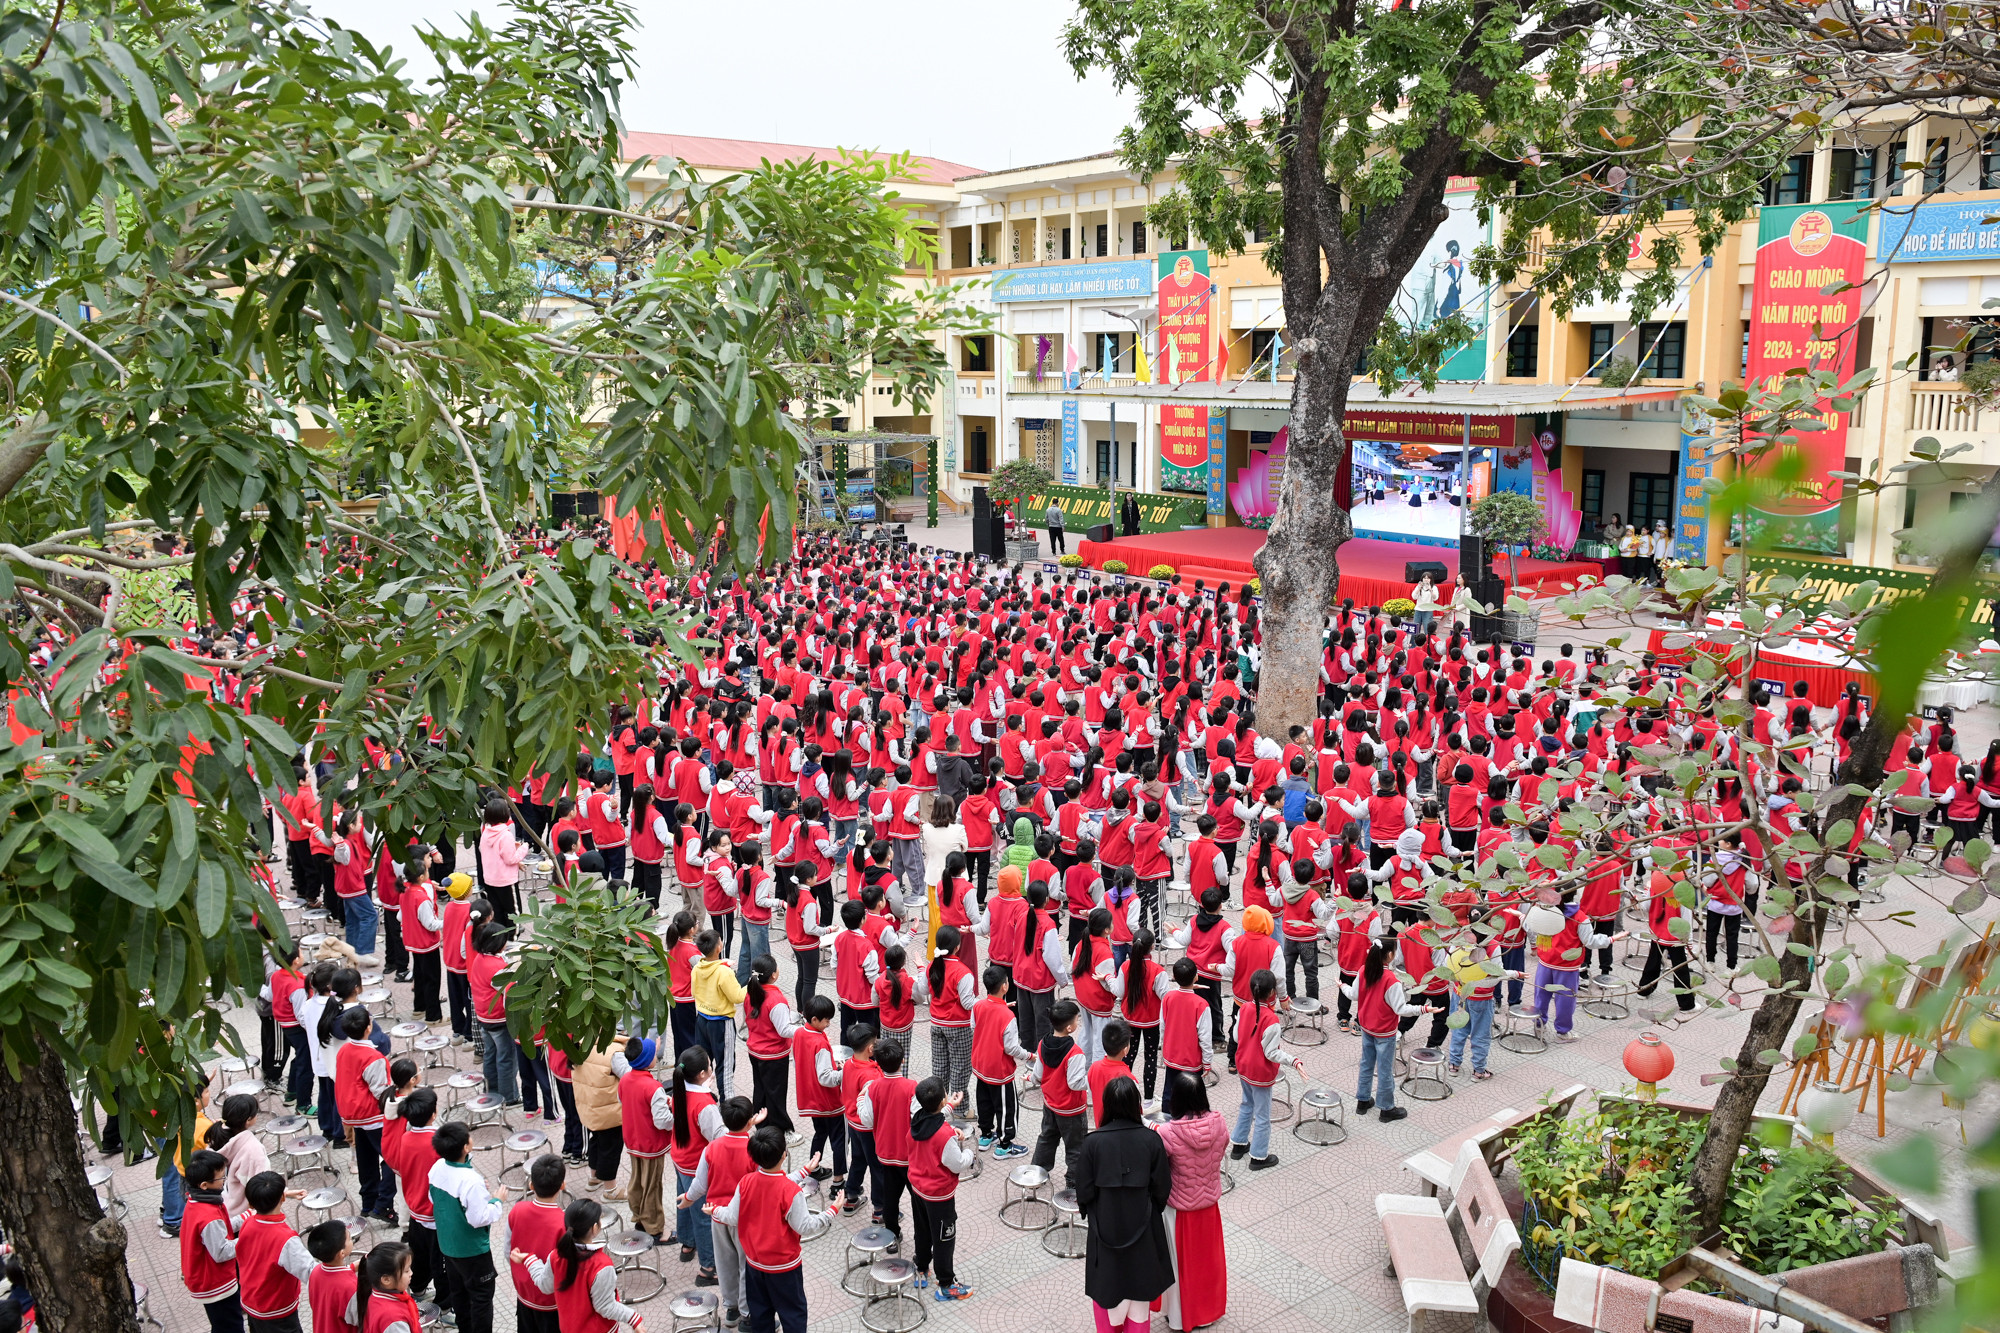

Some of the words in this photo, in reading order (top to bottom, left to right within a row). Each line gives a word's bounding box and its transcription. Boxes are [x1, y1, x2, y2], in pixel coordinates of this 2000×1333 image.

[1904, 234, 1927, 256] HỌC
[1930, 226, 1947, 251] ĐỂ
[1948, 225, 1977, 250] HIỂU
[1978, 225, 2000, 249] BIẾ
[1013, 282, 1036, 296] NHỮNG
[1038, 281, 1048, 294] LỜI
[1050, 281, 1064, 294] HAY,
[1066, 280, 1081, 293] LÀM
[1083, 276, 1106, 292] NHIỀU
[1107, 276, 1124, 294] VIỆC
[1126, 273, 1140, 290] TỐT
[1770, 266, 1802, 289] CHÀO
[1195, 313, 1207, 328] HỌC
[1761, 301, 1789, 324] NĂM
[1792, 304, 1818, 328] HỌC
[1821, 301, 1848, 324] MỚI
[1763, 340, 1793, 359] 2024
[1804, 340, 1837, 360] 2025
[1182, 422, 1196, 438] QUỐC
[1196, 426, 1206, 438] GIA
[1352, 417, 1376, 432] TRĂM
[1377, 418, 1398, 434] NĂM
[1399, 419, 1413, 435] THÌ
[1415, 419, 1436, 436] PHẢI
[1470, 422, 1501, 439] NGƯỜI
[1193, 445, 1198, 456] 2
[1686, 464, 1705, 479] TÍCH
[1685, 486, 1704, 501] CỰC
[1149, 500, 1174, 525] TỐT
[1683, 524, 1701, 539] TẠO
[1762, 682, 1771, 692] ỚP
[1772, 684, 1781, 694] 4D
